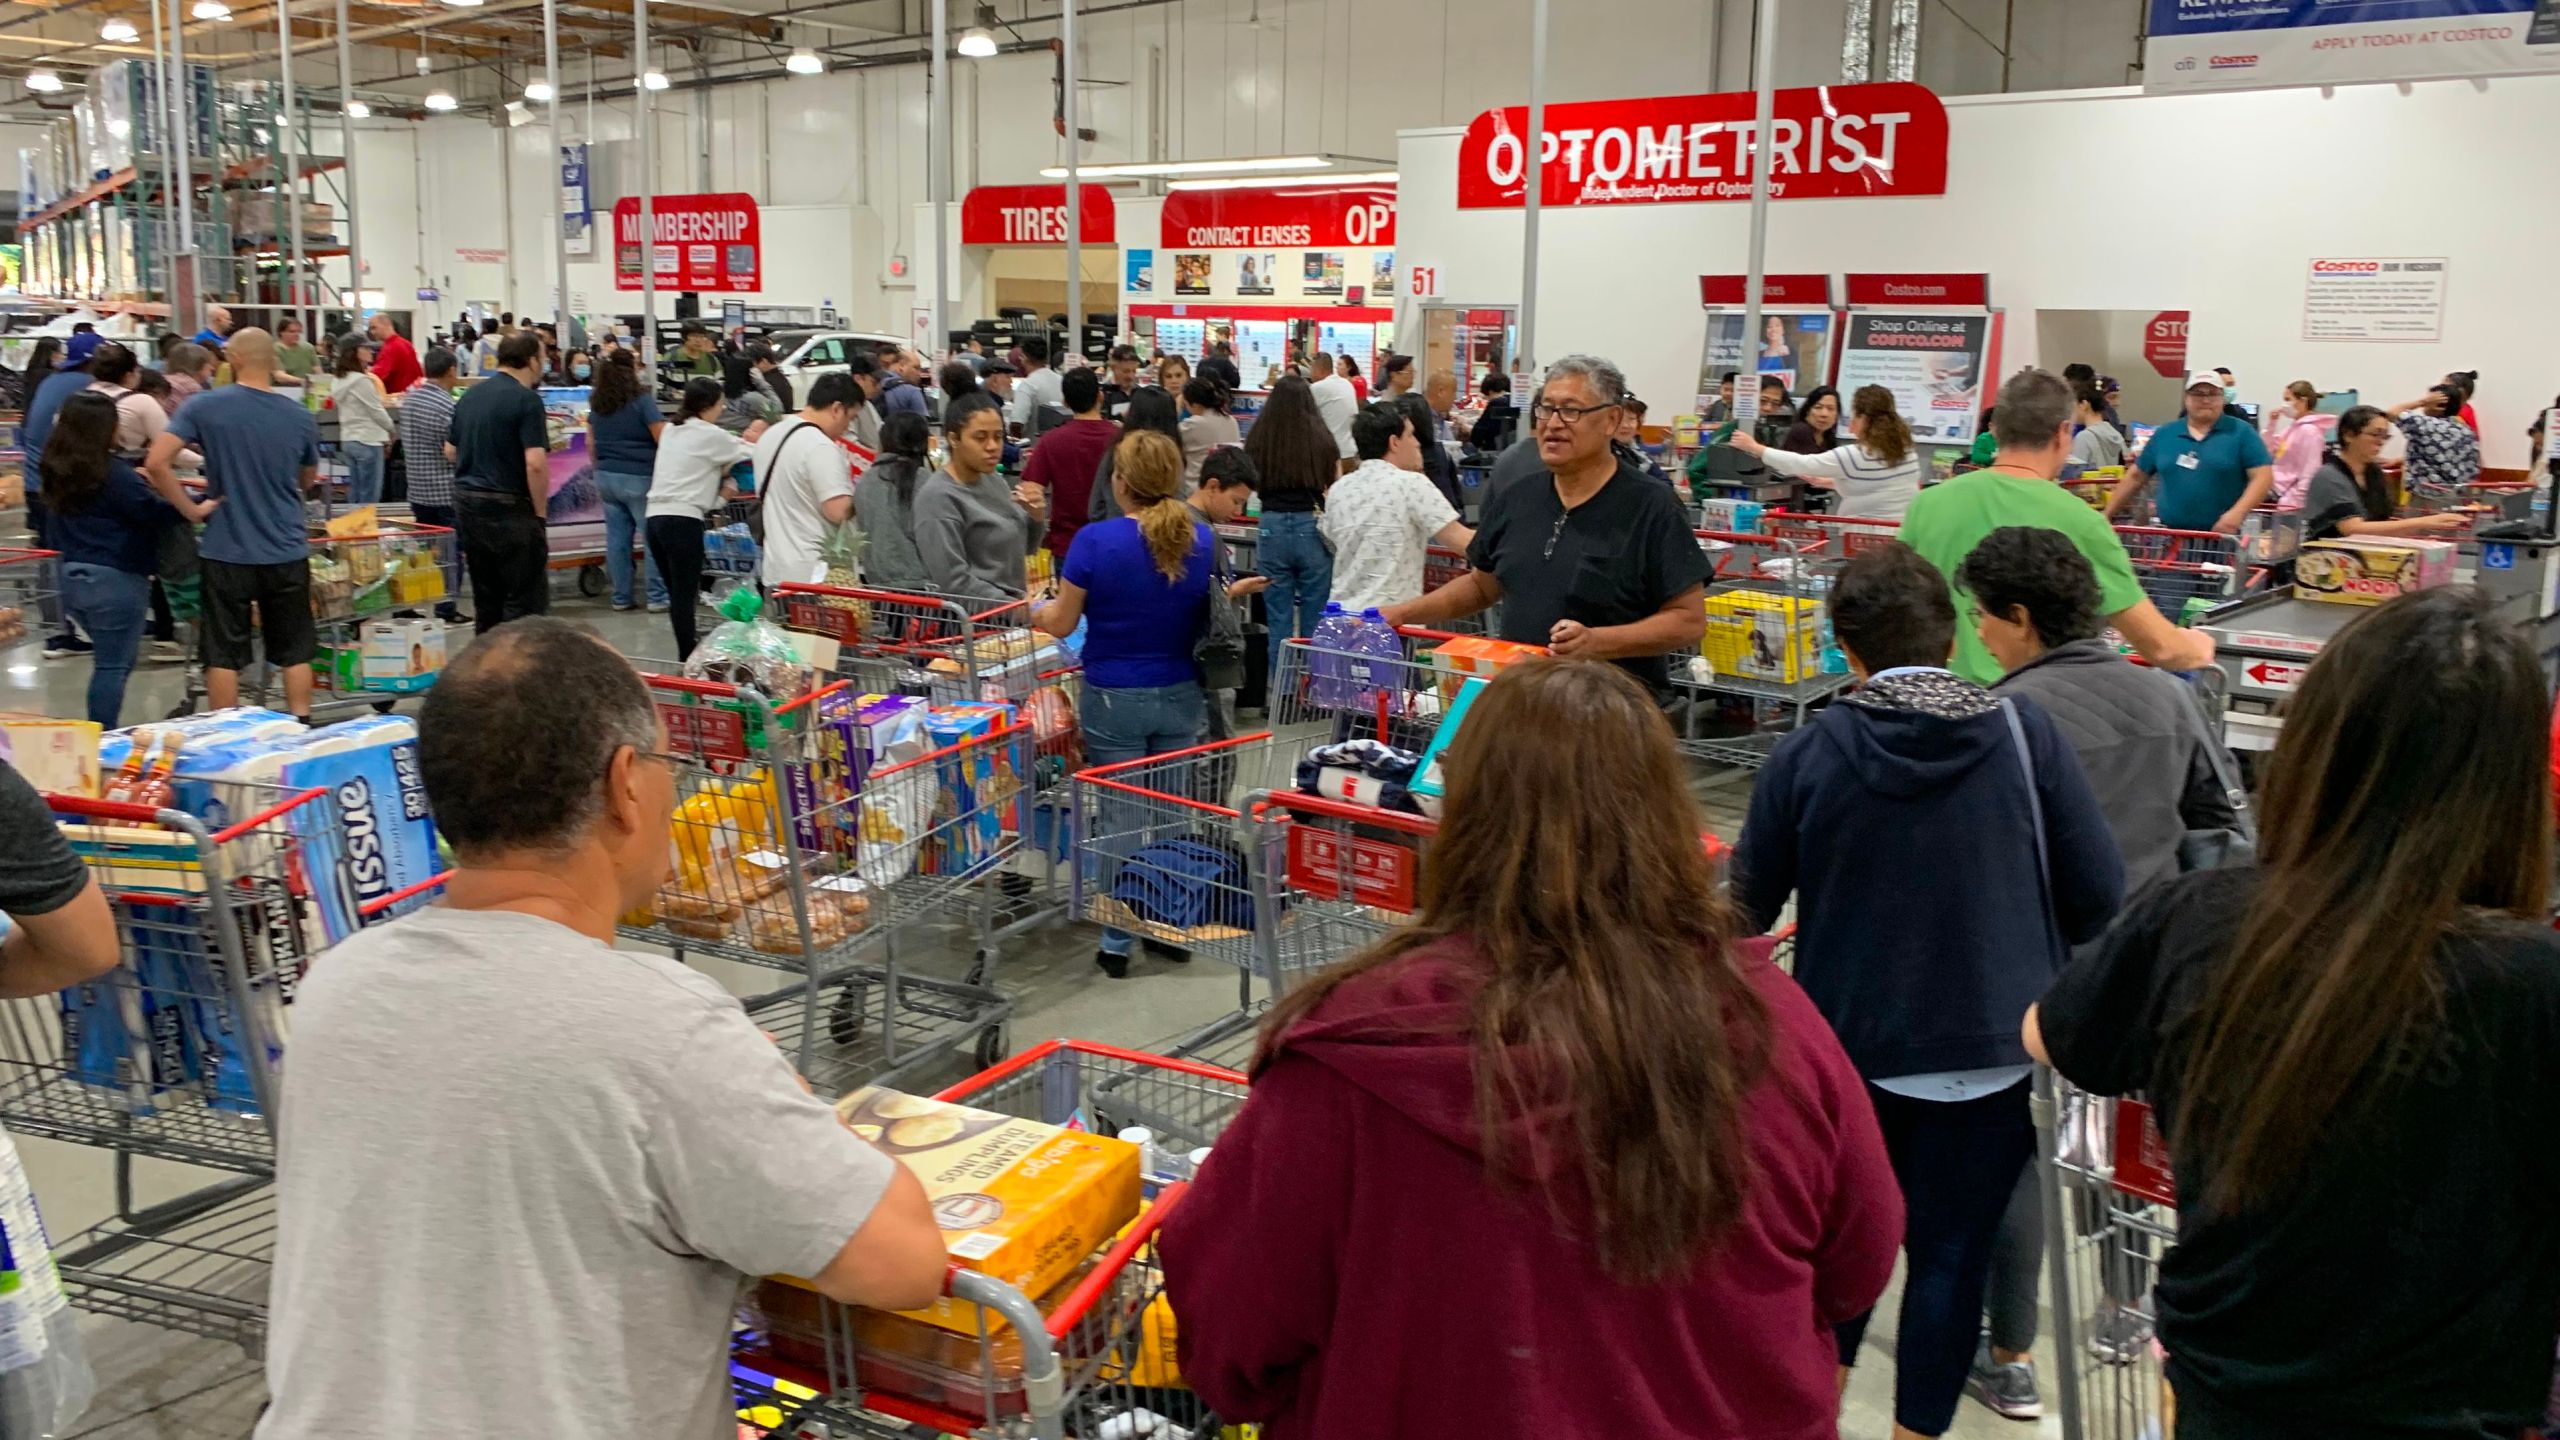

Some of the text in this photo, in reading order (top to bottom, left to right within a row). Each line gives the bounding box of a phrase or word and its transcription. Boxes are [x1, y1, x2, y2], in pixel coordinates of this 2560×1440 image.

[2312, 26, 2513, 50] APPLY TODAY AT COSTCO
[1486, 111, 1911, 187] OPTOMETRIST
[1581, 180, 1786, 199] Independent Doctor of Optomtry
[622, 210, 749, 242] MMBERSHIP
[1001, 207, 1069, 242] TIRES
[1188, 225, 1311, 246] CONTACT LENSES
[2313, 261, 2379, 271] COSTCO
[1412, 267, 1435, 295] 51
[1884, 282, 1946, 296] Costco.com
[1869, 319, 1967, 333] Shop Online at
[1867, 333, 1966, 348] COSTCO.COM
[336, 775, 393, 932] Tissue
[935, 1127, 1026, 1184] DUMPLINGS
[969, 1133, 1044, 1179] STEAMED
[1018, 1137, 1082, 1178] bibigo
